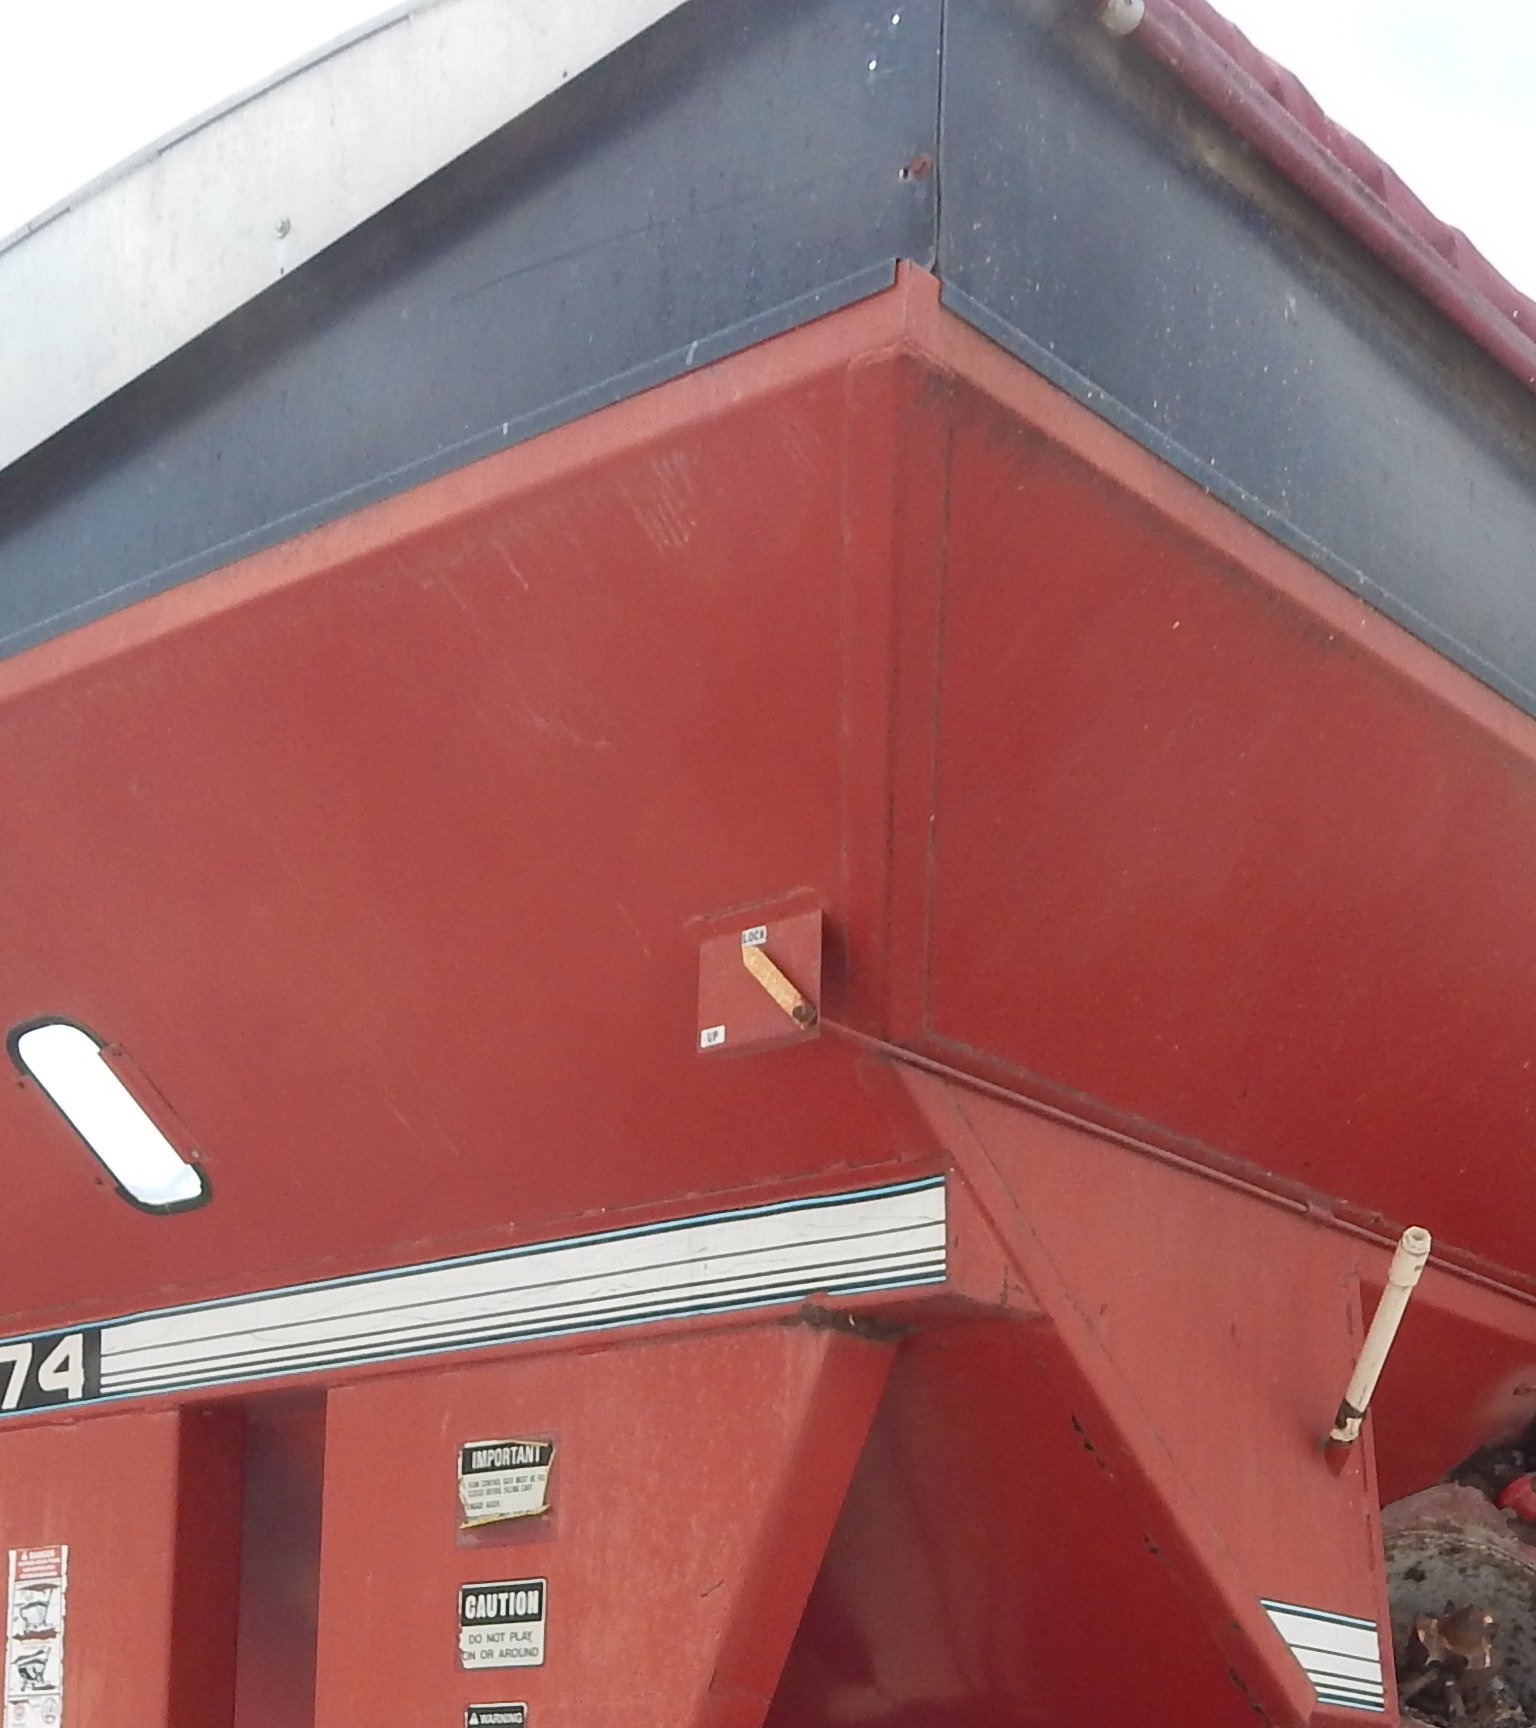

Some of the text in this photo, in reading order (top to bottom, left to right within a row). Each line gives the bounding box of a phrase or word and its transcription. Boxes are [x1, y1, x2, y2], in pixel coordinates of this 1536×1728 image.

[471, 1446, 541, 1469] IMPORTANT
[465, 1590, 539, 1619] CAUTION
[468, 1631, 533, 1644] DO NOT PLAY
[480, 1649, 494, 1659] OR
[498, 1647, 539, 1658] AROUND
